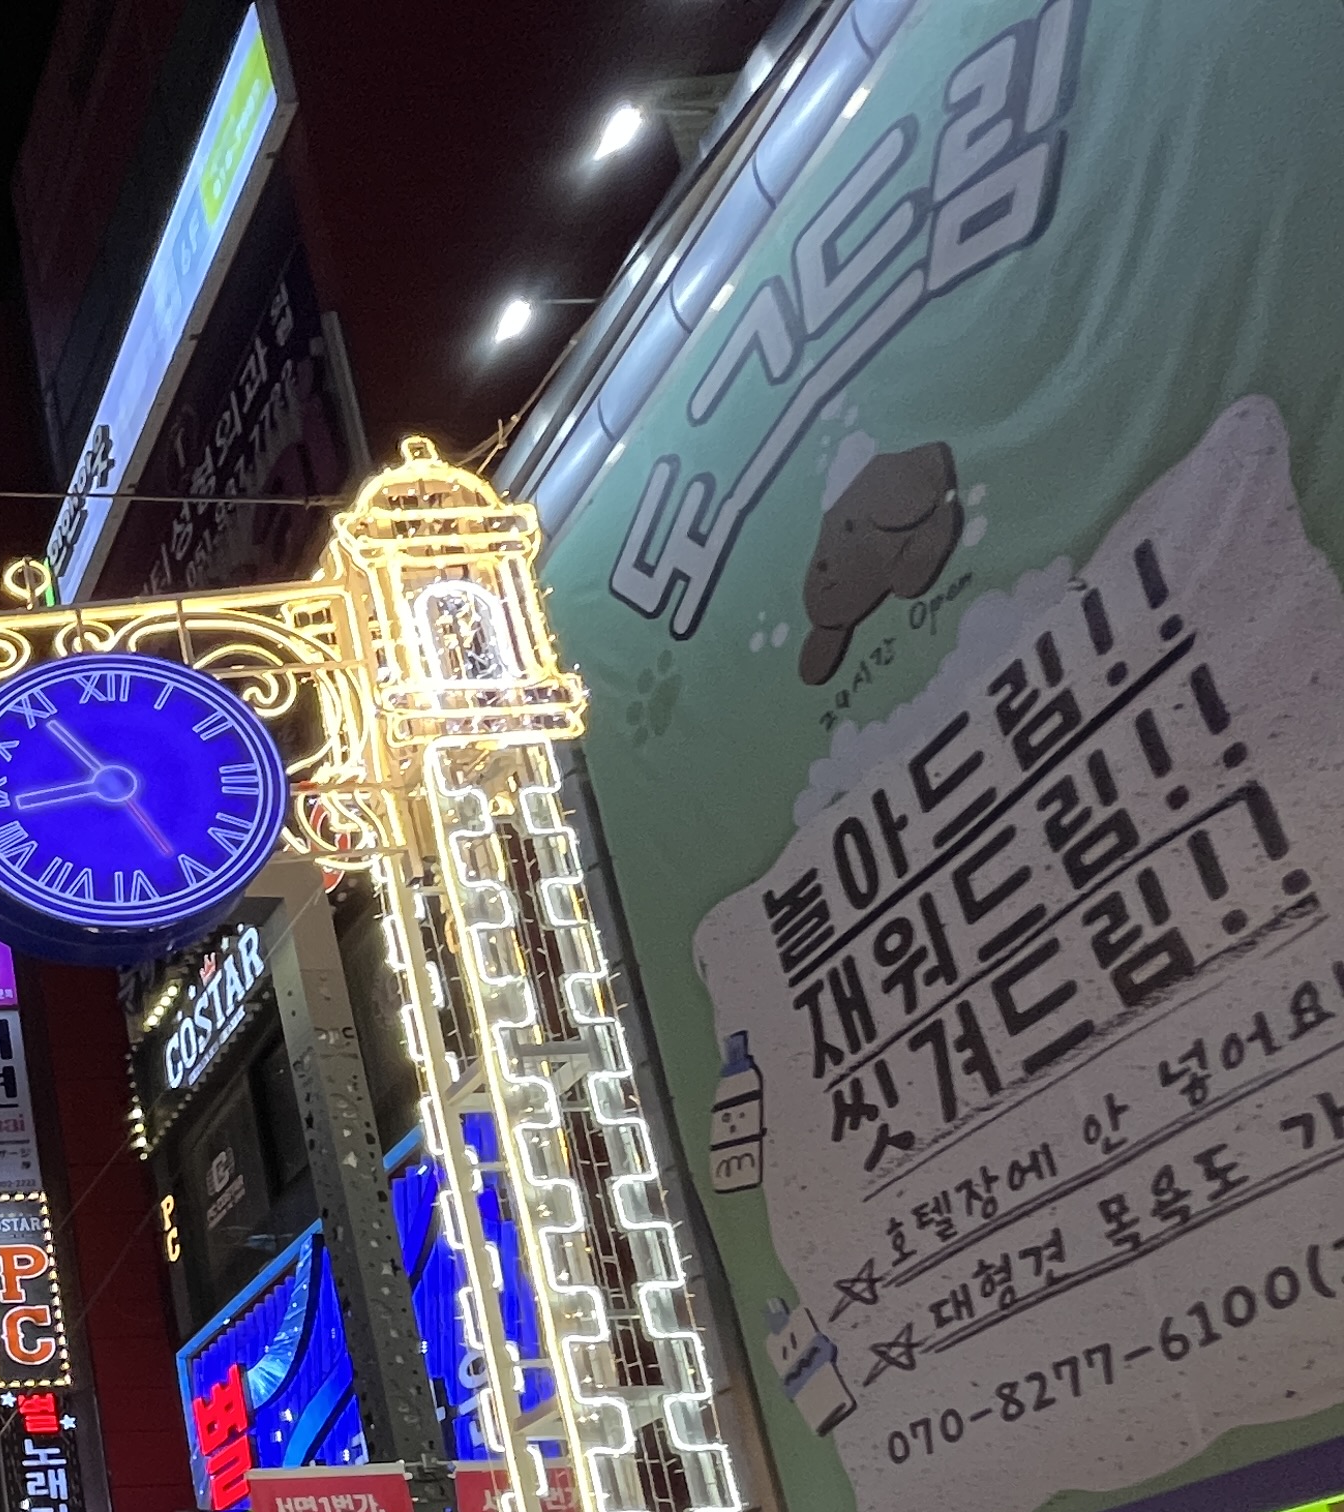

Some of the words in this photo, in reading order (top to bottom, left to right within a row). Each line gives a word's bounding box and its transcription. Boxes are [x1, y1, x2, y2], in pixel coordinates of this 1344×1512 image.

[164, 927, 266, 1089] COSTAR
[161, 1194, 181, 1262] PC
[886, 1142, 1058, 1266] 호텔장에
[1083, 1093, 1131, 1150] 안
[928, 1226, 1067, 1329] 대형견
[1097, 1142, 1250, 1254] 목욕도
[18, 1392, 60, 1433] 별
[192, 1362, 253, 1512] 별
